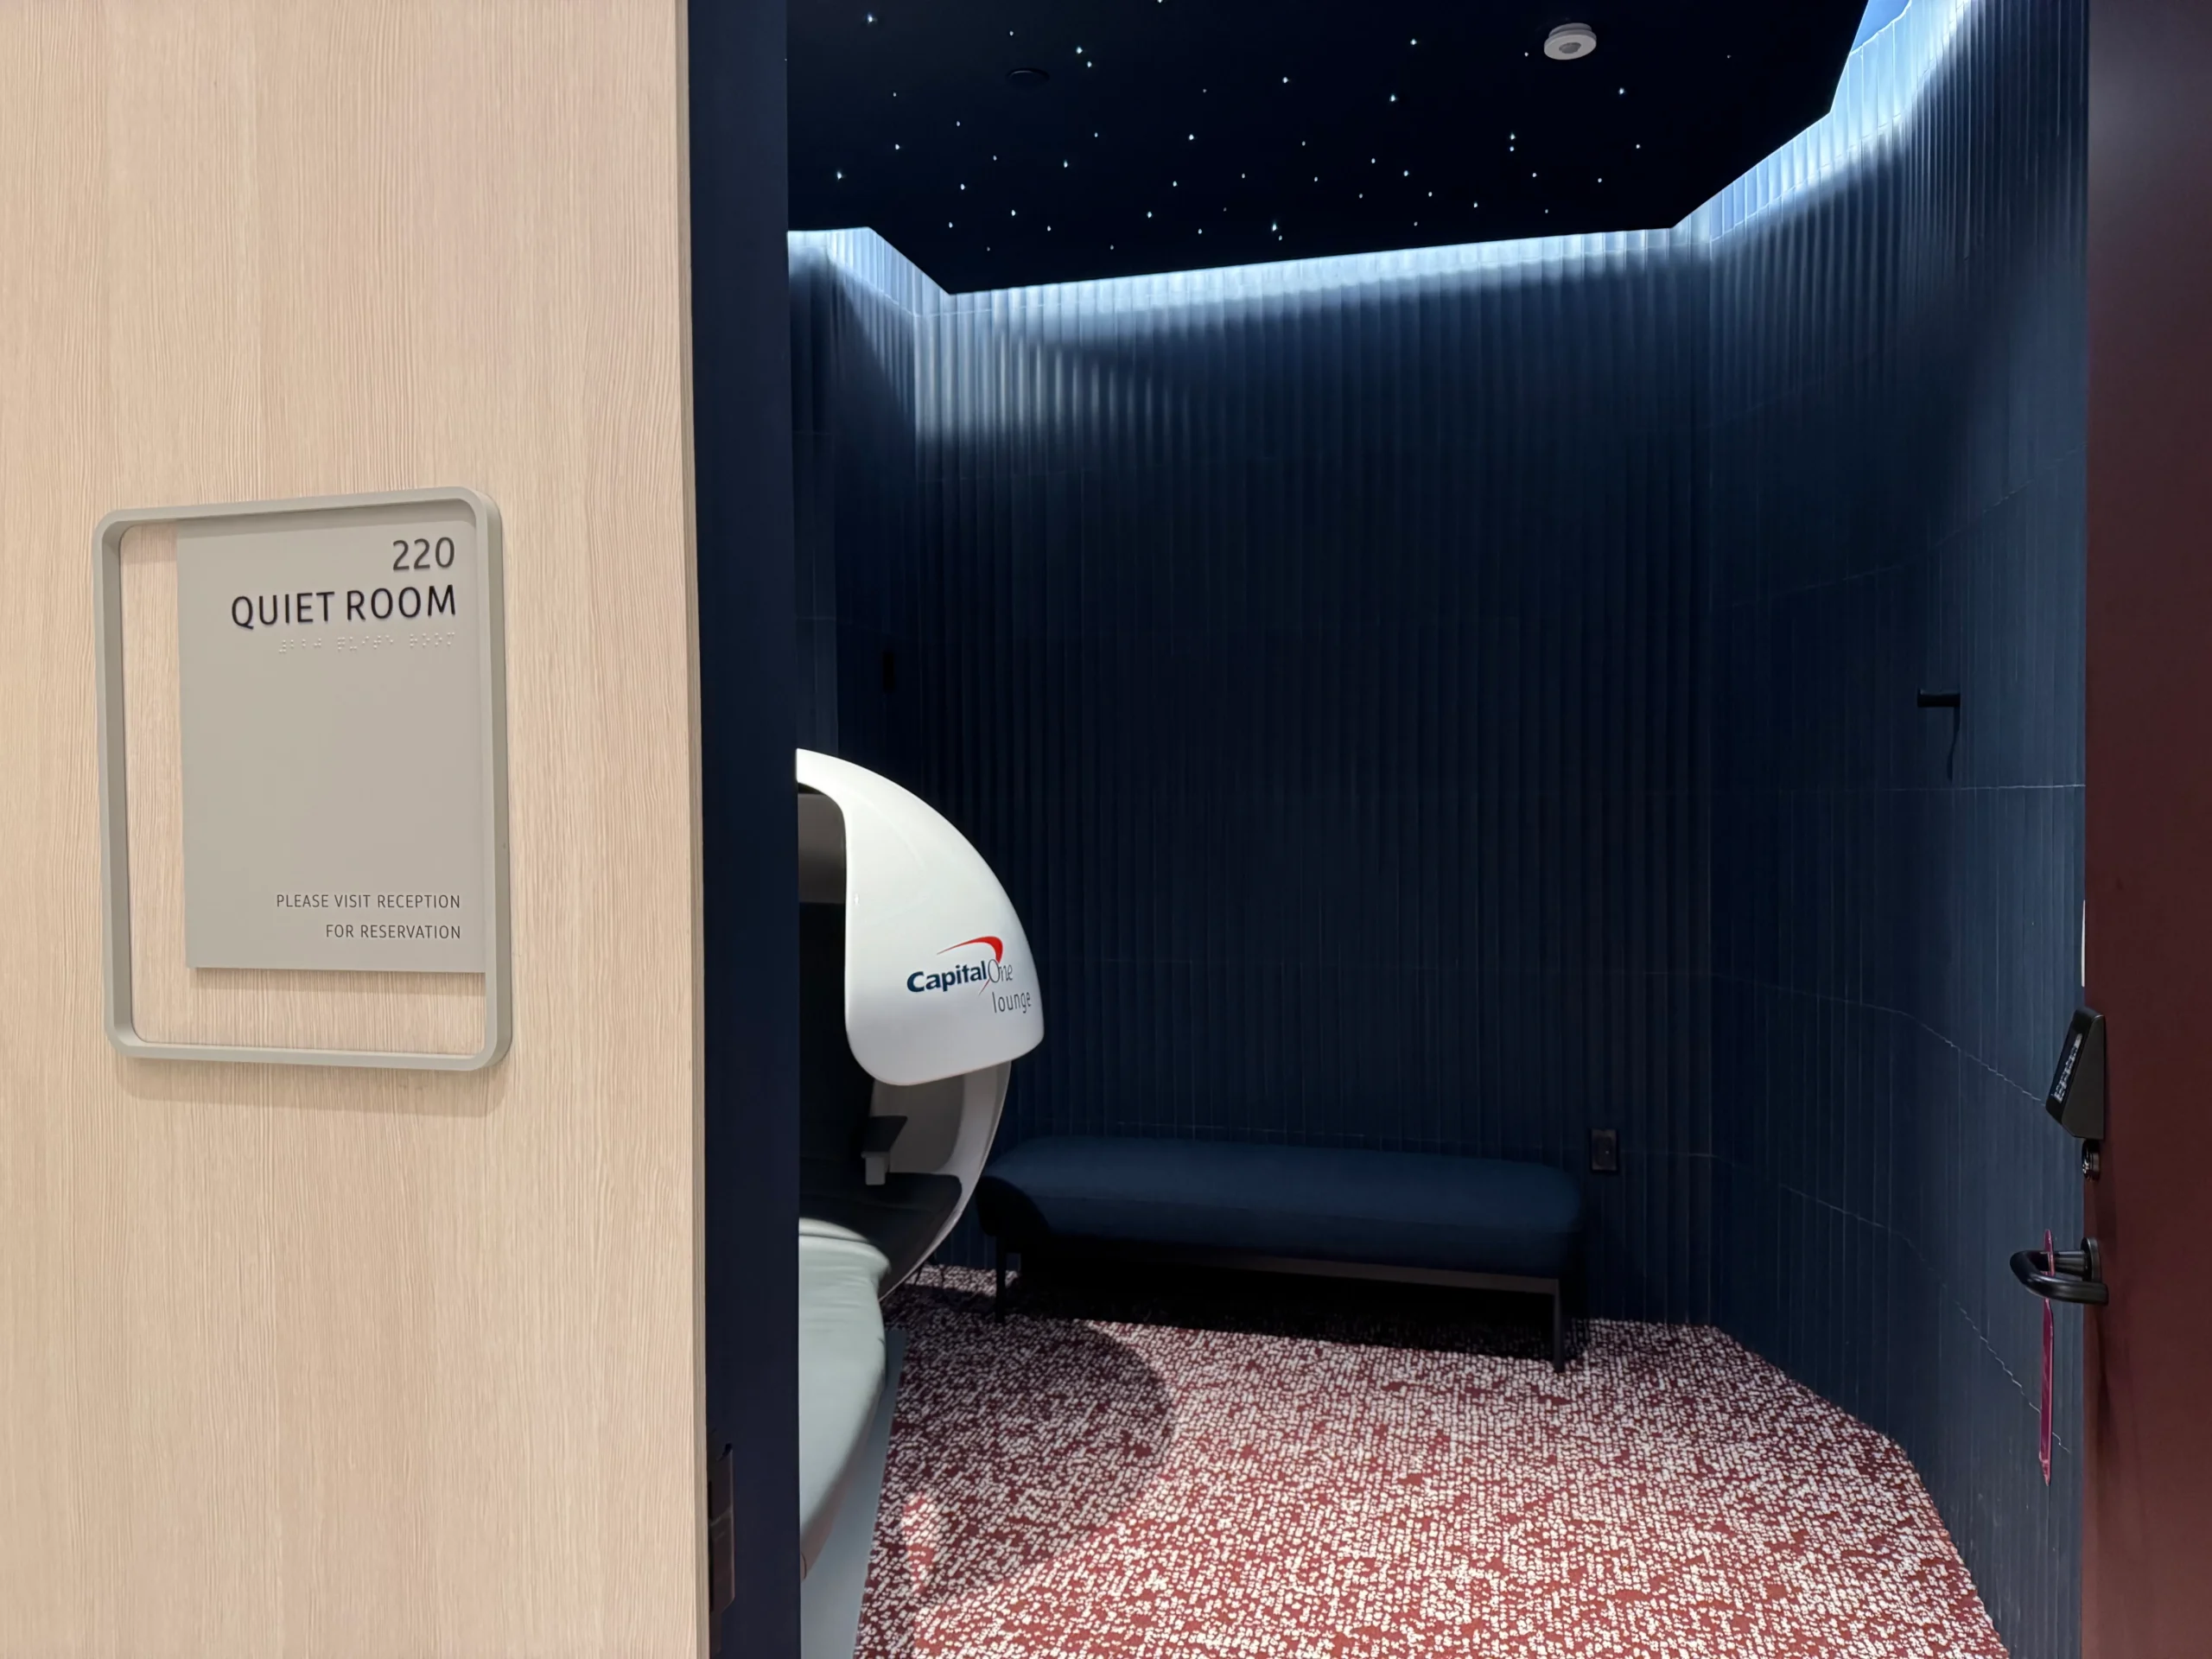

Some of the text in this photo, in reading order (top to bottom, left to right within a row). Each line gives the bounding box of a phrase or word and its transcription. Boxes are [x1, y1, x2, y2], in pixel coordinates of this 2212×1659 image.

[392, 537, 455, 571] 220
[232, 584, 456, 630] QUIET ROOM
[276, 893, 461, 909] PLEASE VISIT RECEPTION
[326, 924, 461, 939] FOR RESERVATION
[992, 991, 1032, 1014] lounge
